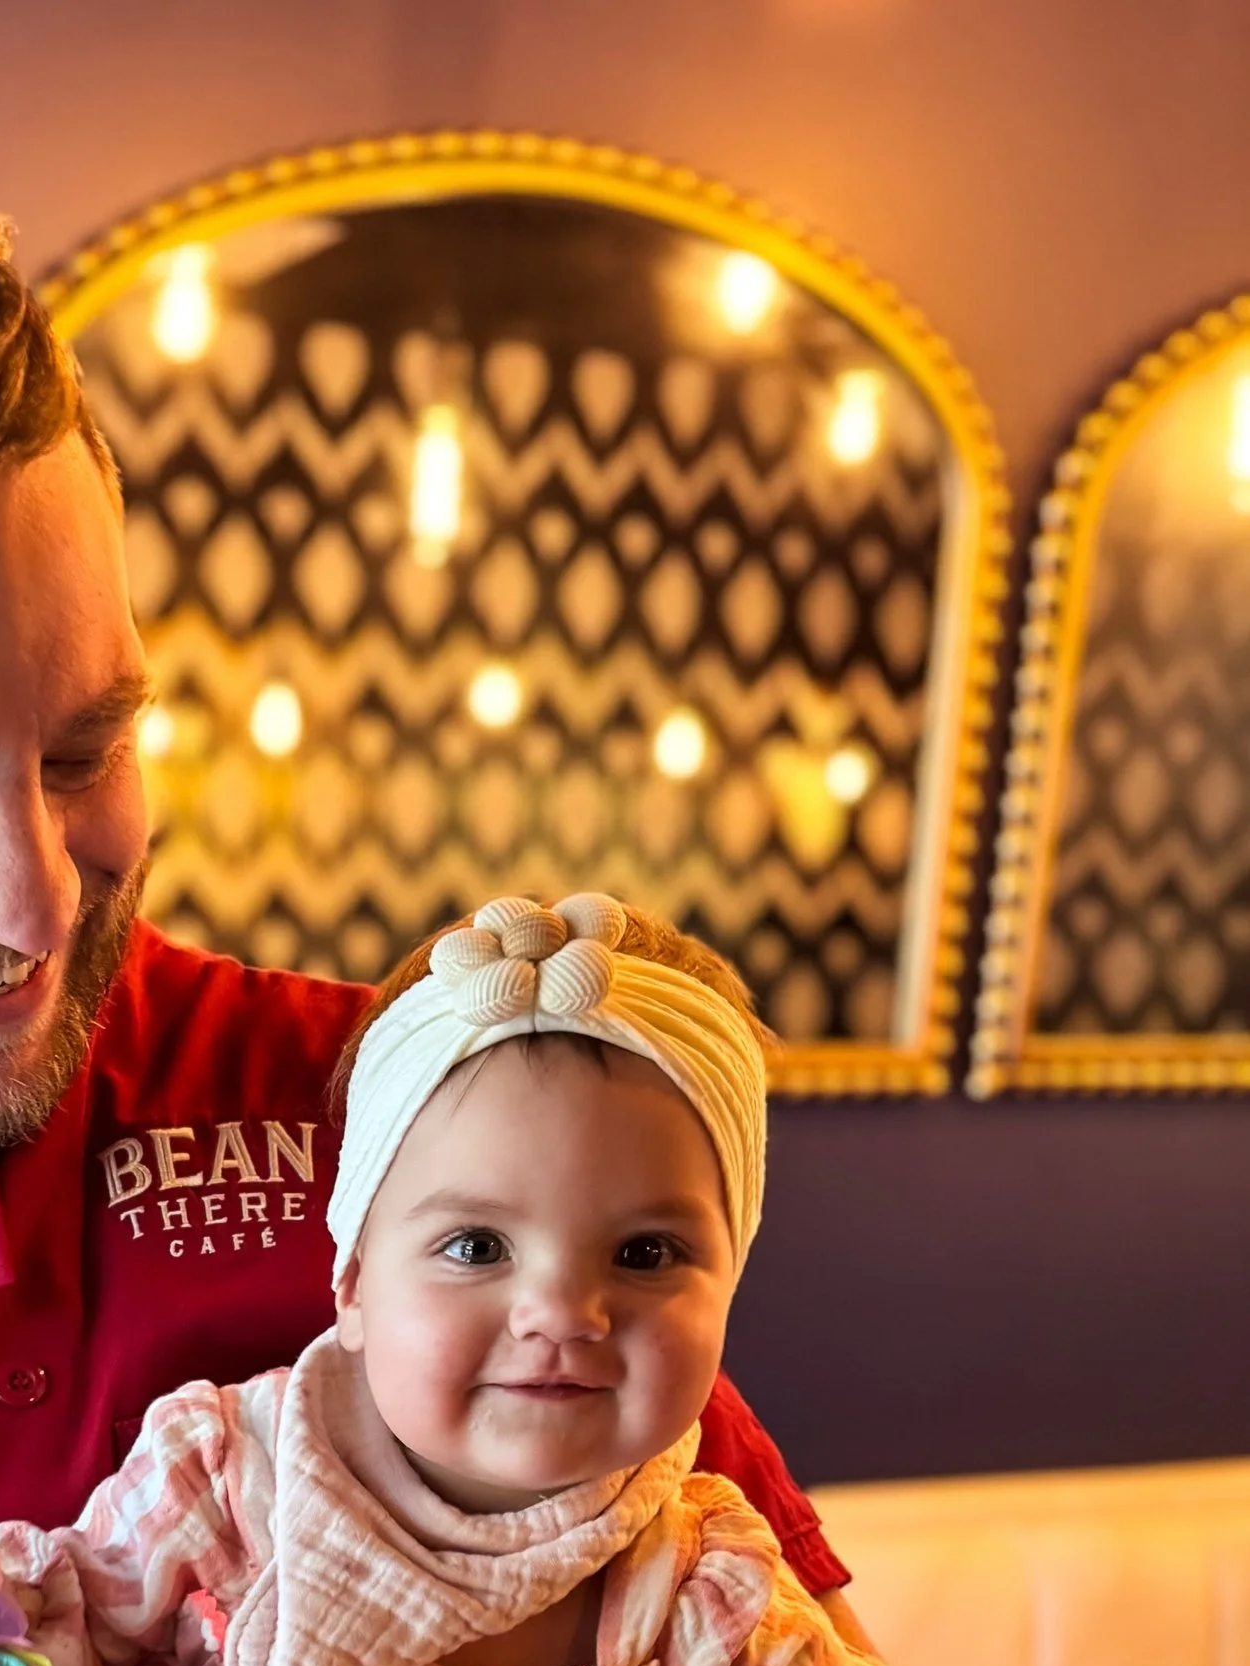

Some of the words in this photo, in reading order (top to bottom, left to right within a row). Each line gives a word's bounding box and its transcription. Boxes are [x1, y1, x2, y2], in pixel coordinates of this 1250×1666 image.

[97, 1120, 318, 1208] BEAN
[120, 1192, 307, 1240] THERE
[169, 1226, 277, 1258] CAFÉ
